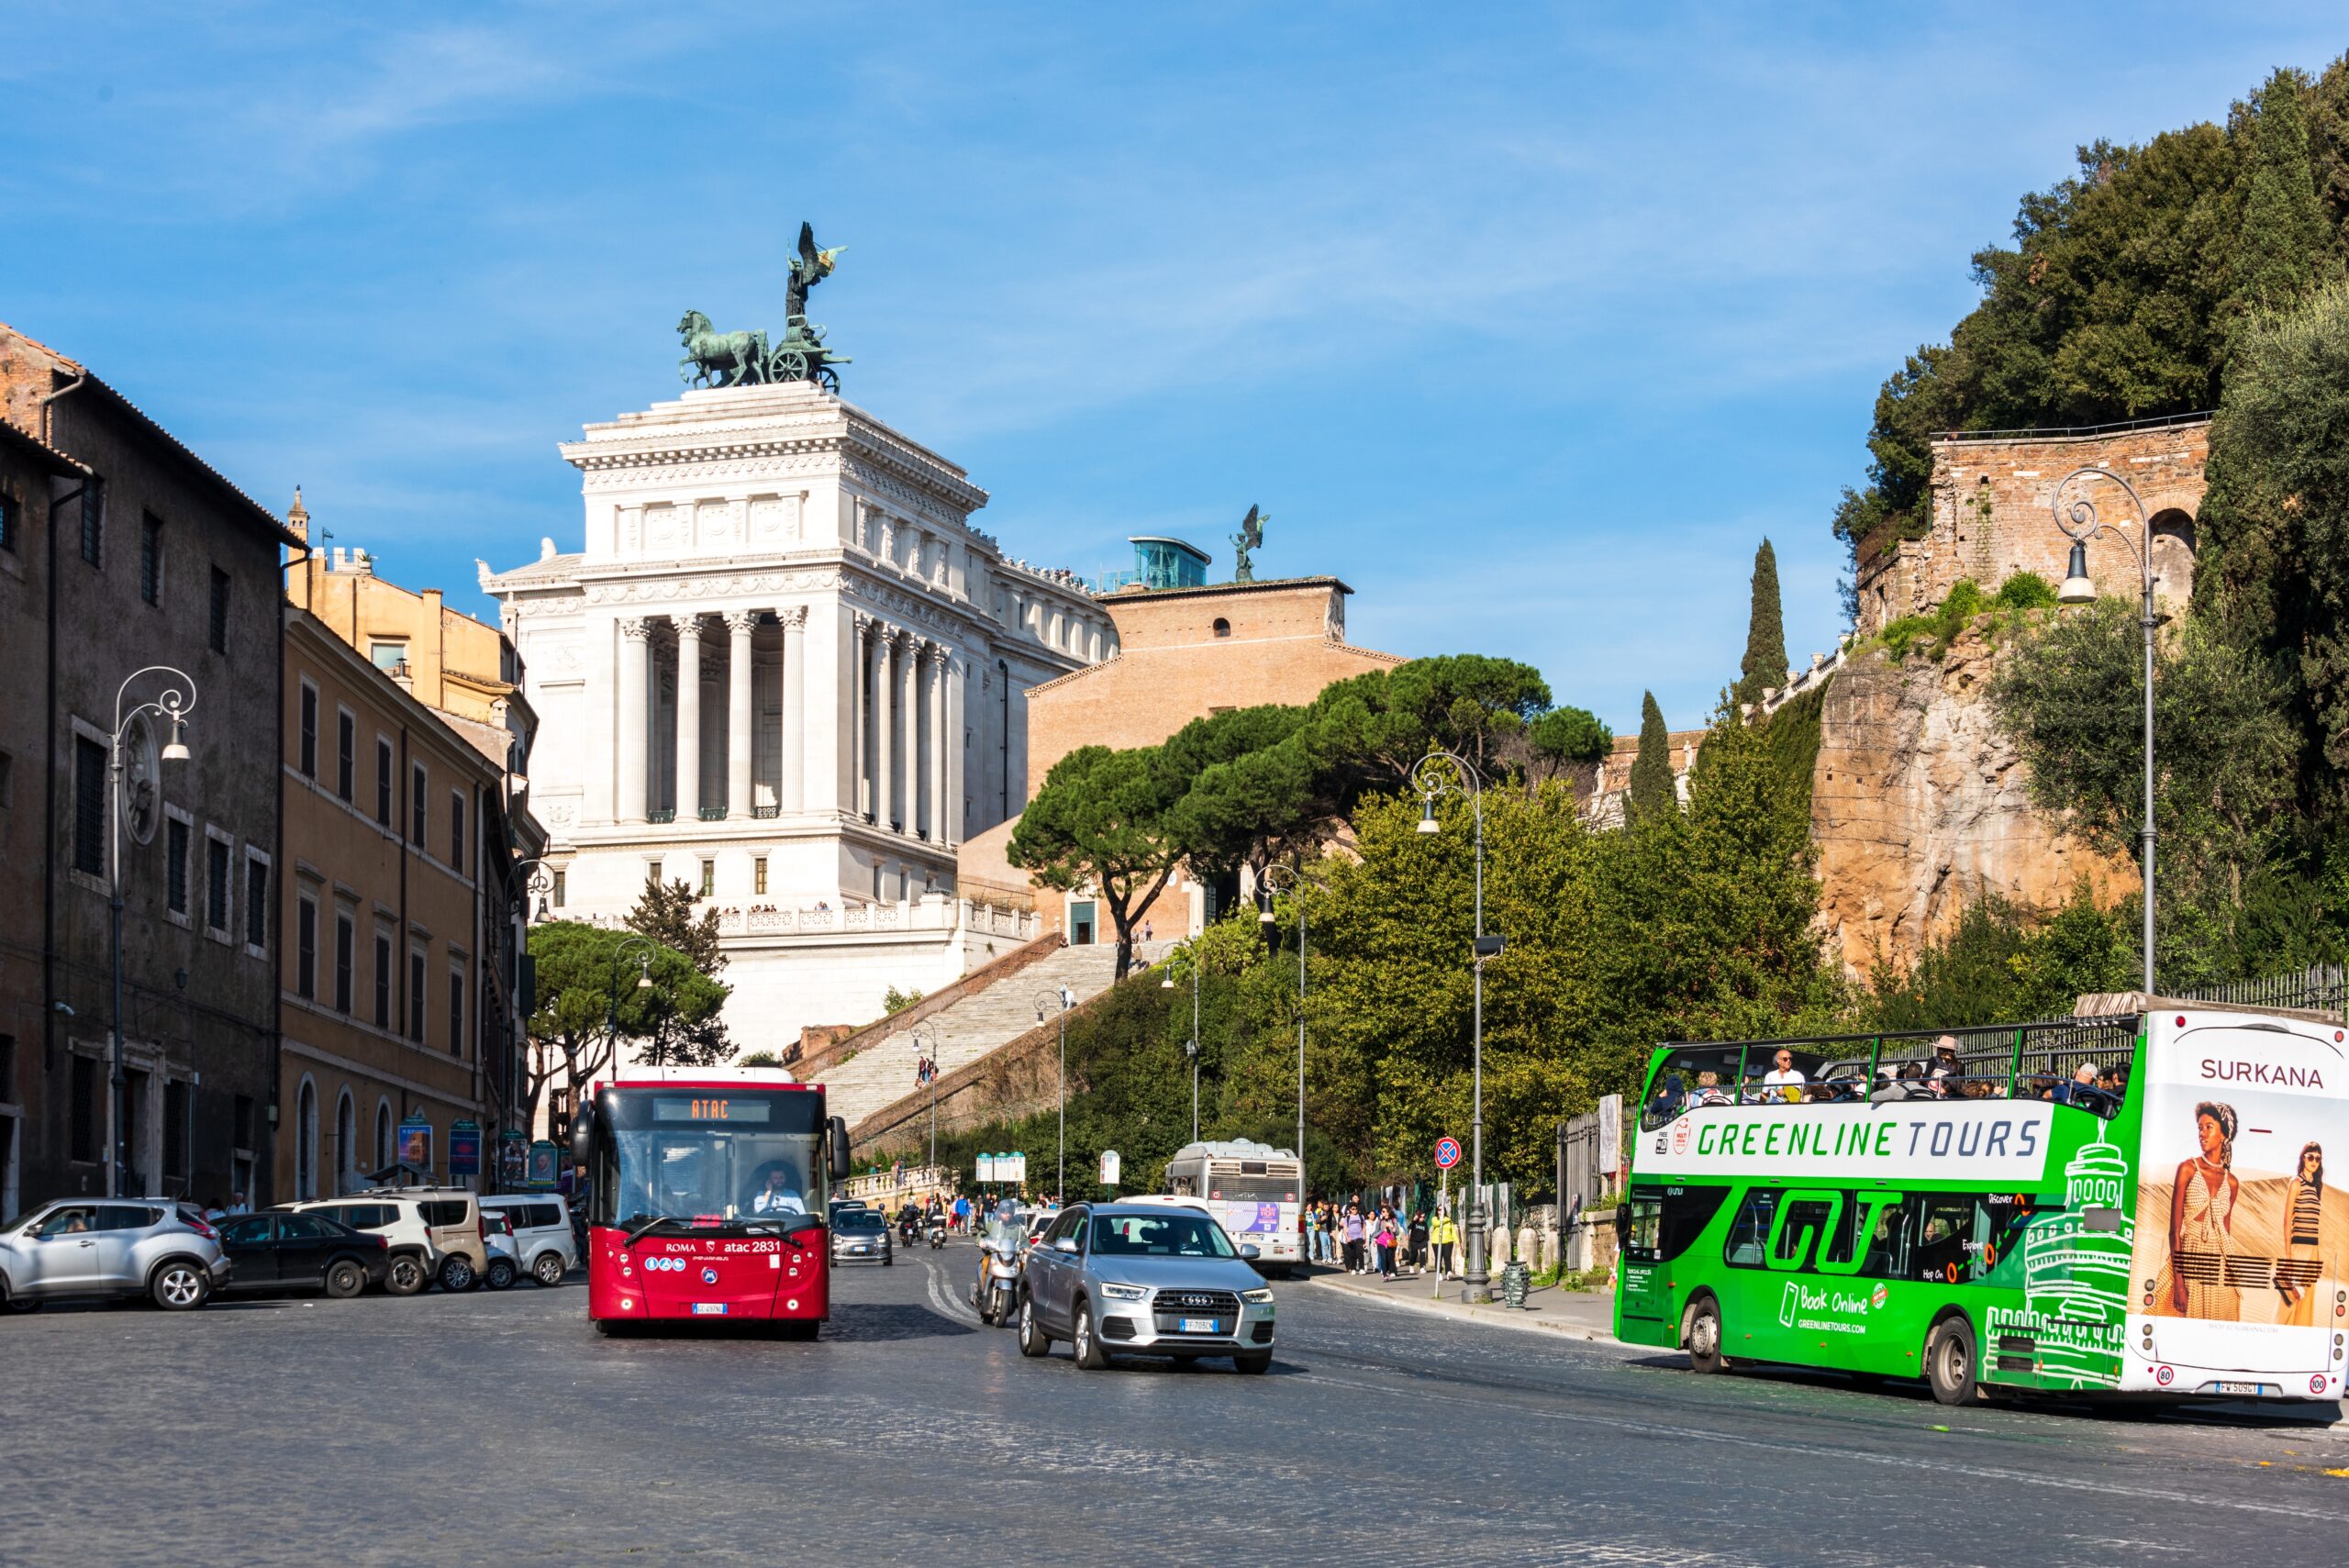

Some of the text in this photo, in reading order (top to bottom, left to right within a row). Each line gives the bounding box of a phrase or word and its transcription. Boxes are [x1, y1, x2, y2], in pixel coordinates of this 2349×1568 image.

[2201, 1059, 2323, 1089] SURKANA
[692, 1100, 729, 1119] ATAC
[1698, 1120, 2041, 1156] GREENLINE TOURS
[1988, 1193, 2013, 1205] Discover
[666, 1243, 696, 1252] ROMA
[724, 1241, 780, 1252] atac 2831
[1962, 1239, 1984, 1252] Explore
[1922, 1269, 1943, 1282] Hop On
[1801, 1284, 1828, 1310] Book
[1831, 1292, 1868, 1315] Online
[1798, 1319, 1866, 1334] GREENLINETOURS.COM
[2160, 1372, 2170, 1380] 80
[2311, 1380, 2324, 1388] 100
